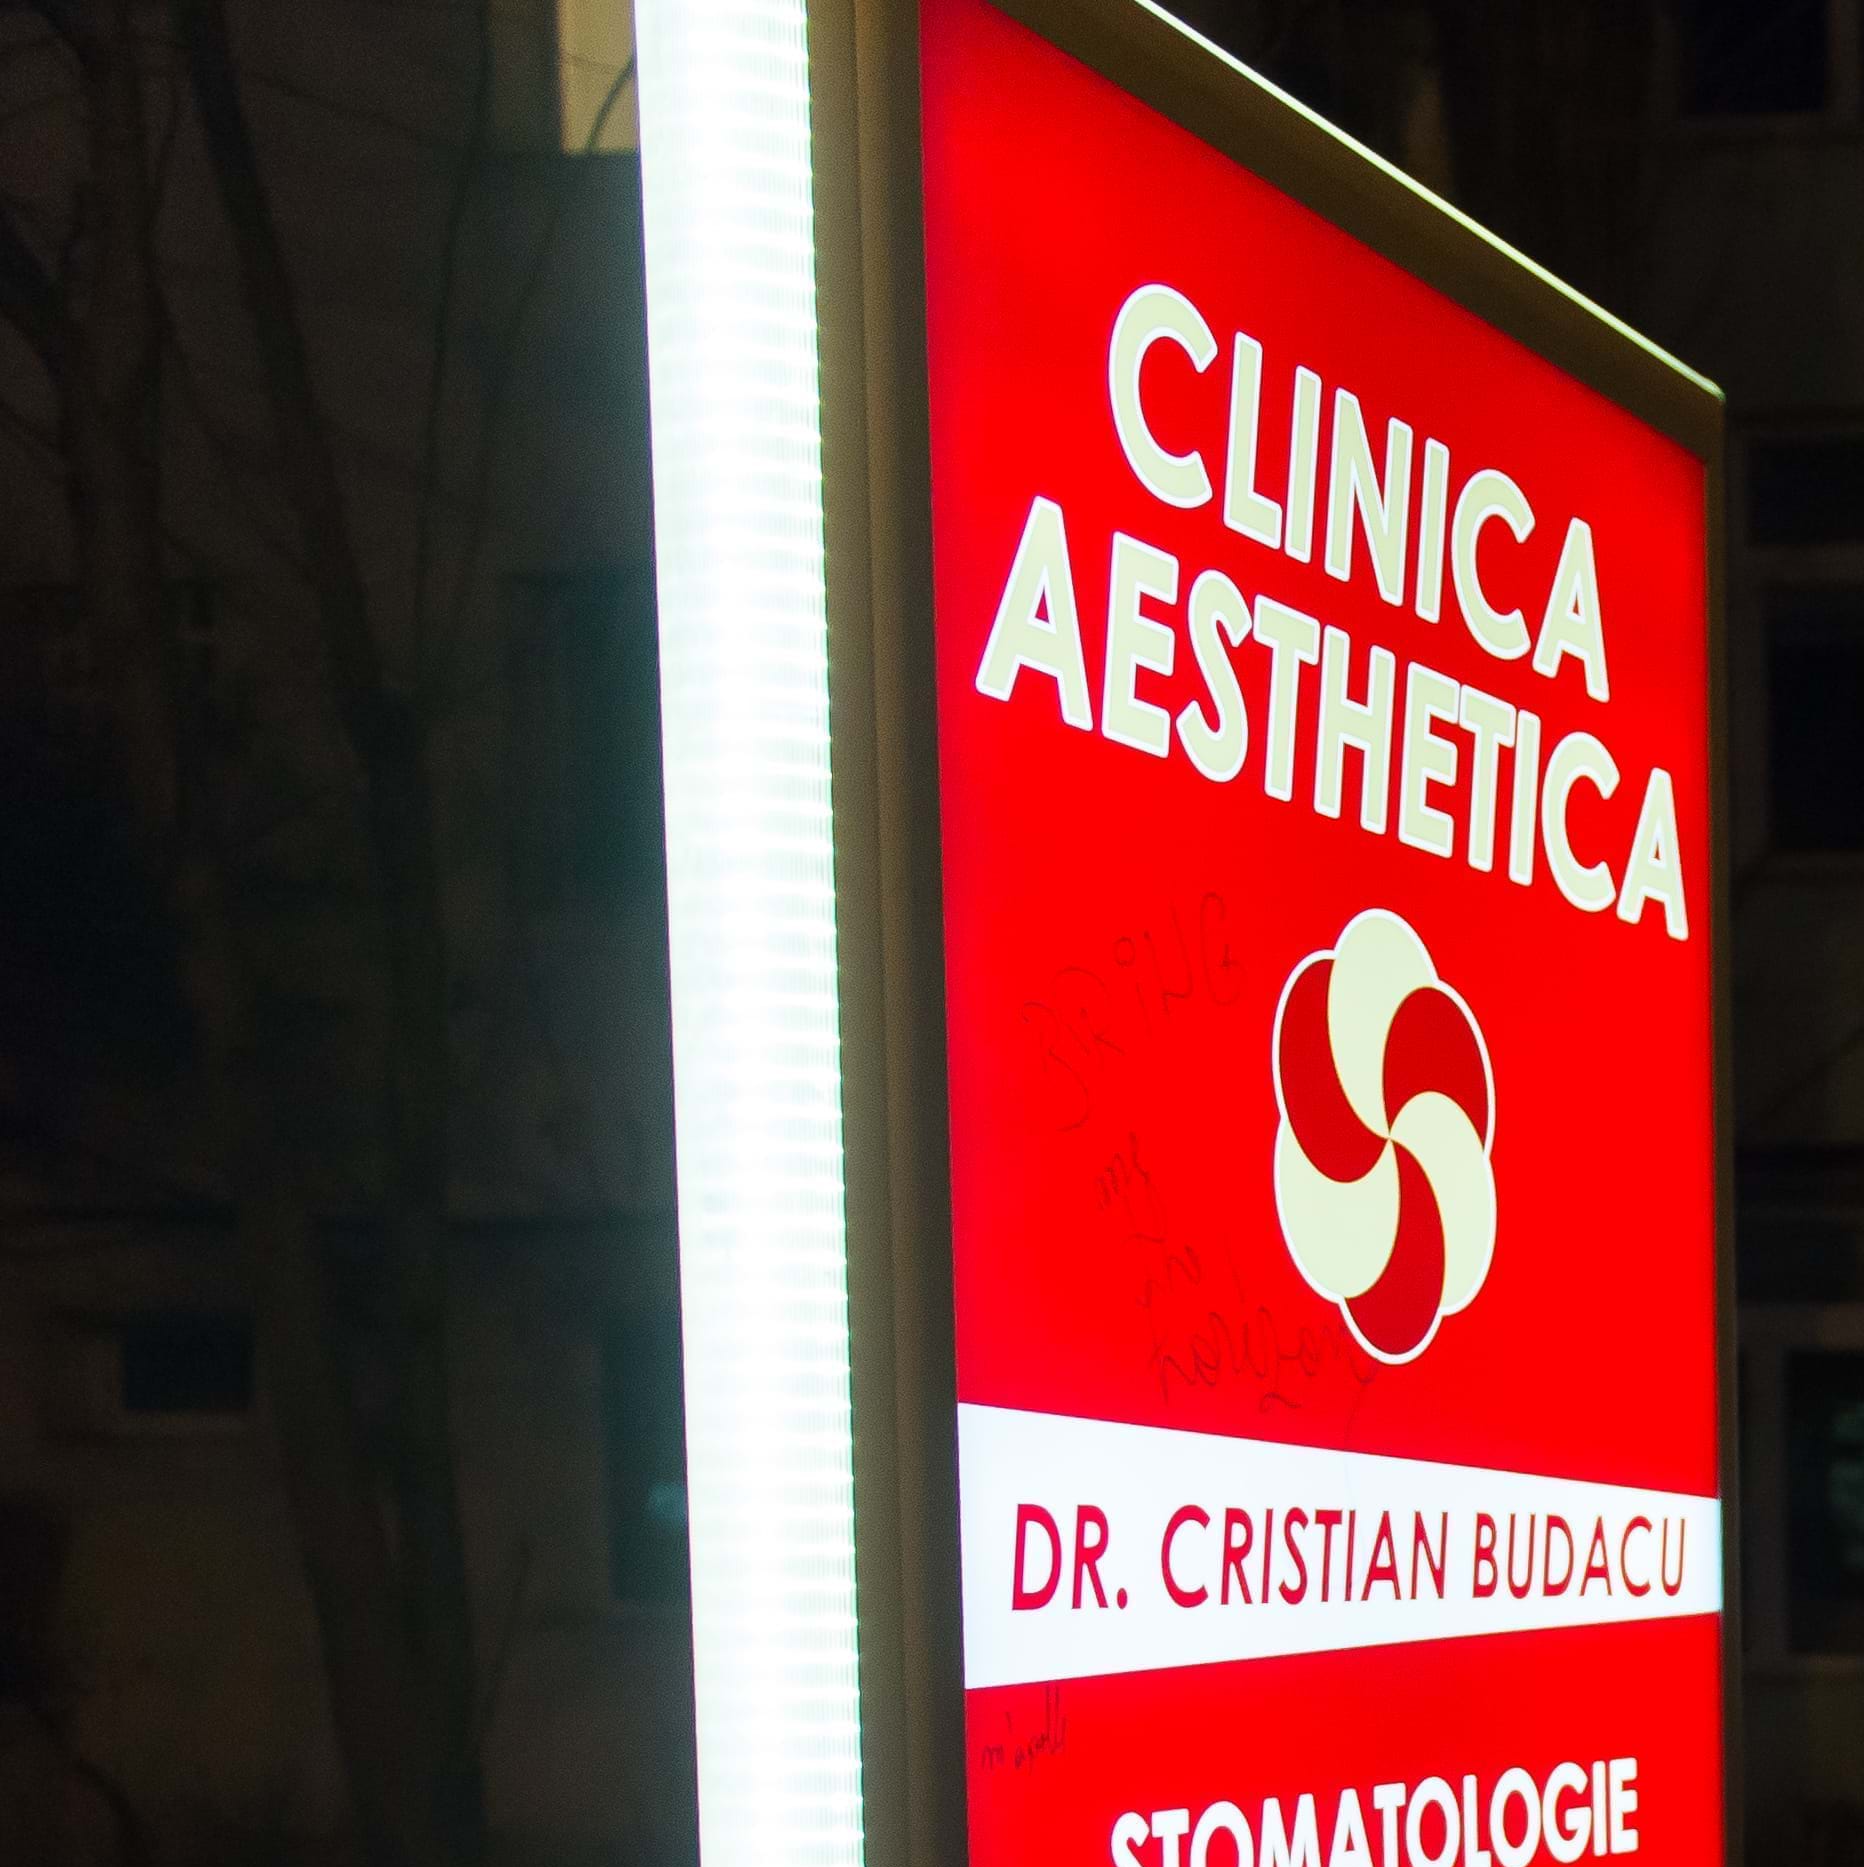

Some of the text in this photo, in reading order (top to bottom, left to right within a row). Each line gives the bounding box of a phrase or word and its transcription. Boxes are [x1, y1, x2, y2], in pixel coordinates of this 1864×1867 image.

[1107, 282, 1611, 702] CLINICA
[973, 495, 1691, 941] AESTHETICA
[1011, 1504, 1687, 1611] DR. CRISTIAN BUDACU
